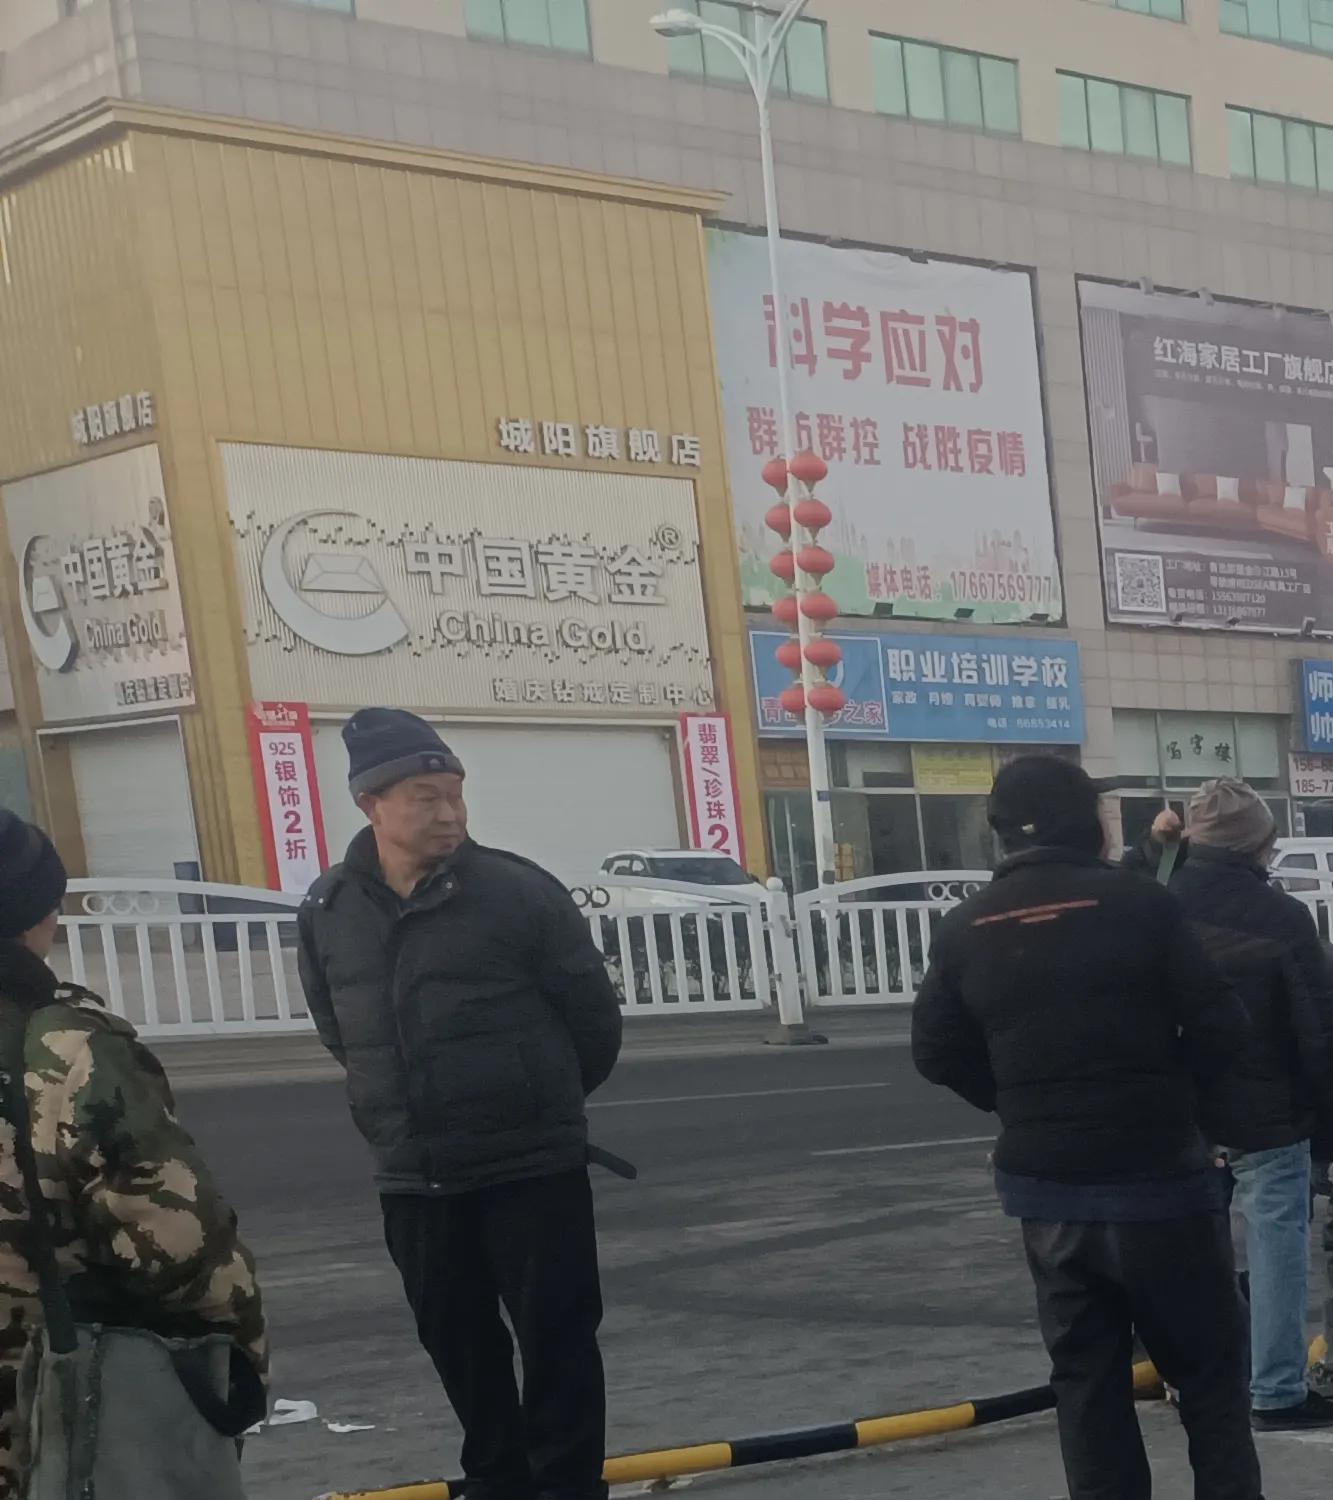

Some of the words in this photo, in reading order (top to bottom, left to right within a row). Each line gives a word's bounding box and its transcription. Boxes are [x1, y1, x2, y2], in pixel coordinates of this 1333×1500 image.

[763, 294, 983, 393] 科学应对
[498, 417, 700, 466] 城阳旗舰店
[902, 422, 1026, 477] 战胜疫情
[61, 526, 168, 602] 中国黄金
[402, 534, 667, 605] 中国黄金
[84, 618, 124, 649] China
[128, 611, 162, 645] Gold
[437, 611, 550, 647] China
[559, 617, 648, 651] Gold
[887, 648, 1069, 688] 职业培训学校
